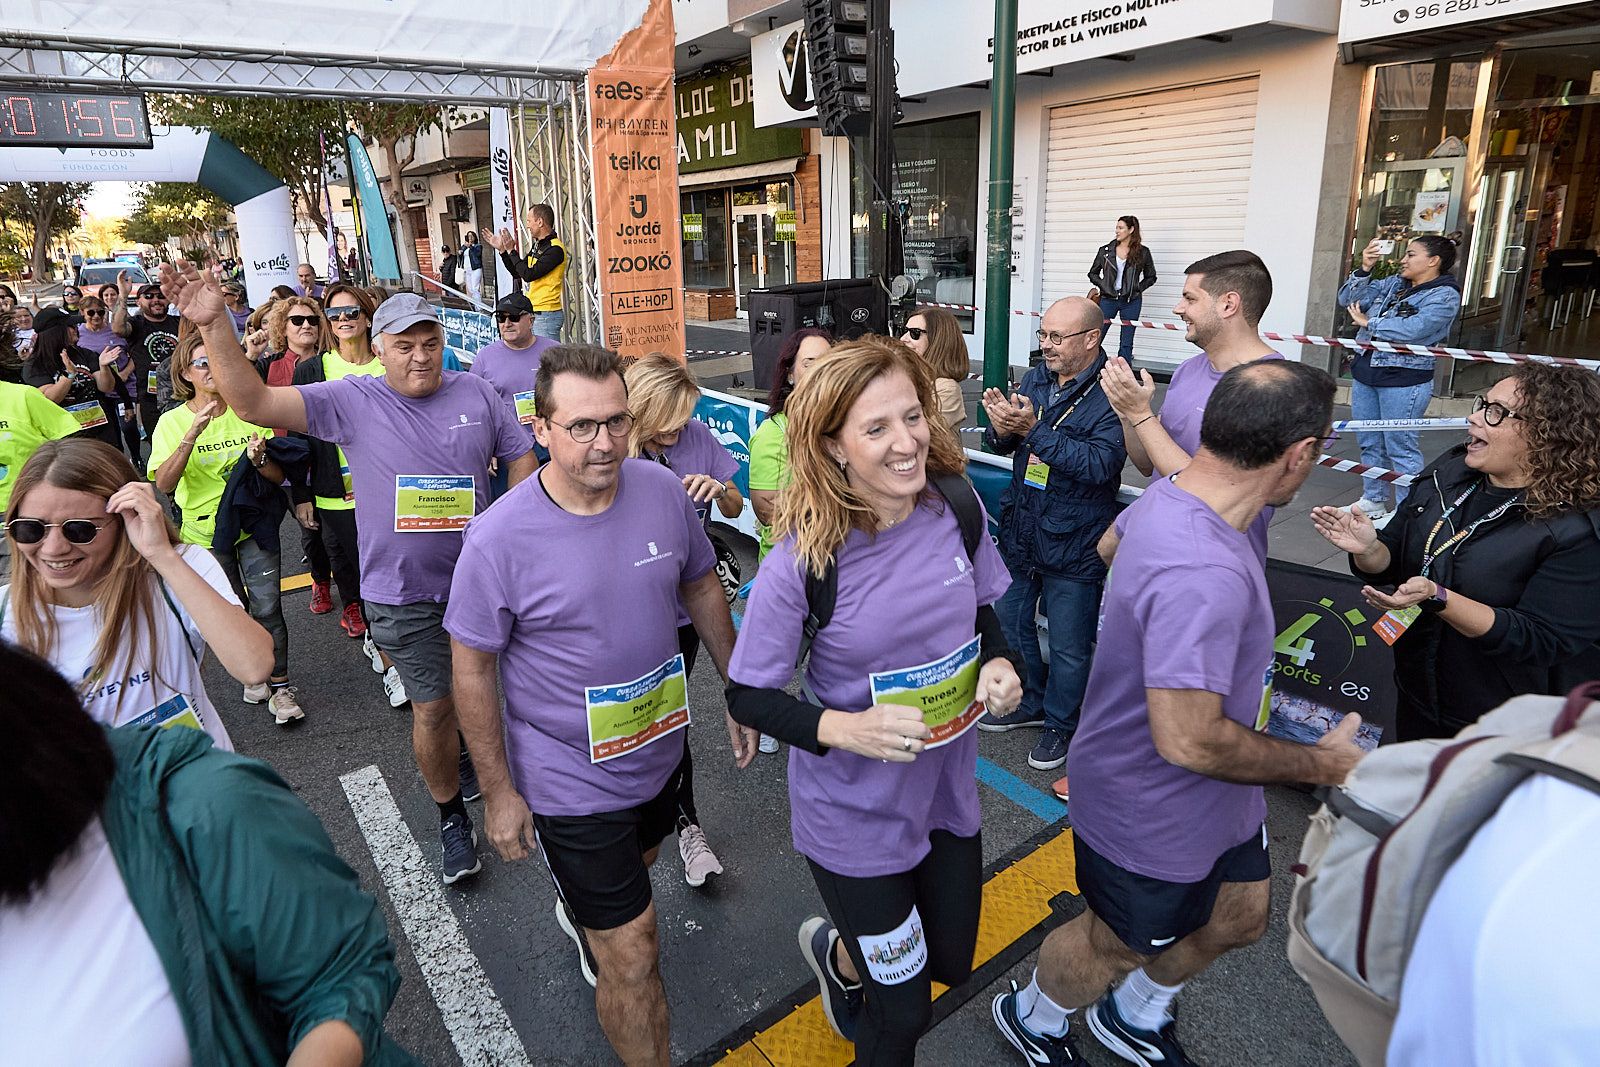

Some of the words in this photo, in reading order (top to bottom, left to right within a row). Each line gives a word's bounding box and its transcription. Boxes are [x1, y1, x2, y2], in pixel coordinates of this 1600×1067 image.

[1415, 4, 1440, 19] 96
[1445, 0, 1480, 14] 281
[1017, 15, 1077, 41] RKETPLACE
[1081, 5, 1122, 24] FÍSICO
[1017, 41, 1049, 57] ECTOR
[1053, 34, 1067, 48] DE
[1070, 31, 1085, 44] LA
[1088, 16, 1148, 39] VIVIENDA
[595, 81, 643, 100] faes
[676, 85, 715, 119] LOC
[596, 118, 612, 128] RH
[619, 118, 668, 130] BAYREN
[90, 149, 136, 157] FOODS
[609, 150, 661, 171] teika
[62, 163, 129, 171] FUNDACIÓN
[253, 260, 267, 271] be
[268, 254, 290, 270] plus
[608, 251, 672, 274] ZOOKÖ
[617, 294, 668, 309] ALE-HOP
[626, 322, 679, 336] AJUNTAMENT
[625, 337, 637, 347] DE
[638, 334, 671, 345] GANDIA
[1273, 612, 1322, 668] 4
[1273, 661, 1322, 686] ports
[920, 686, 957, 705] Teresa
[632, 699, 654, 715] Pere
